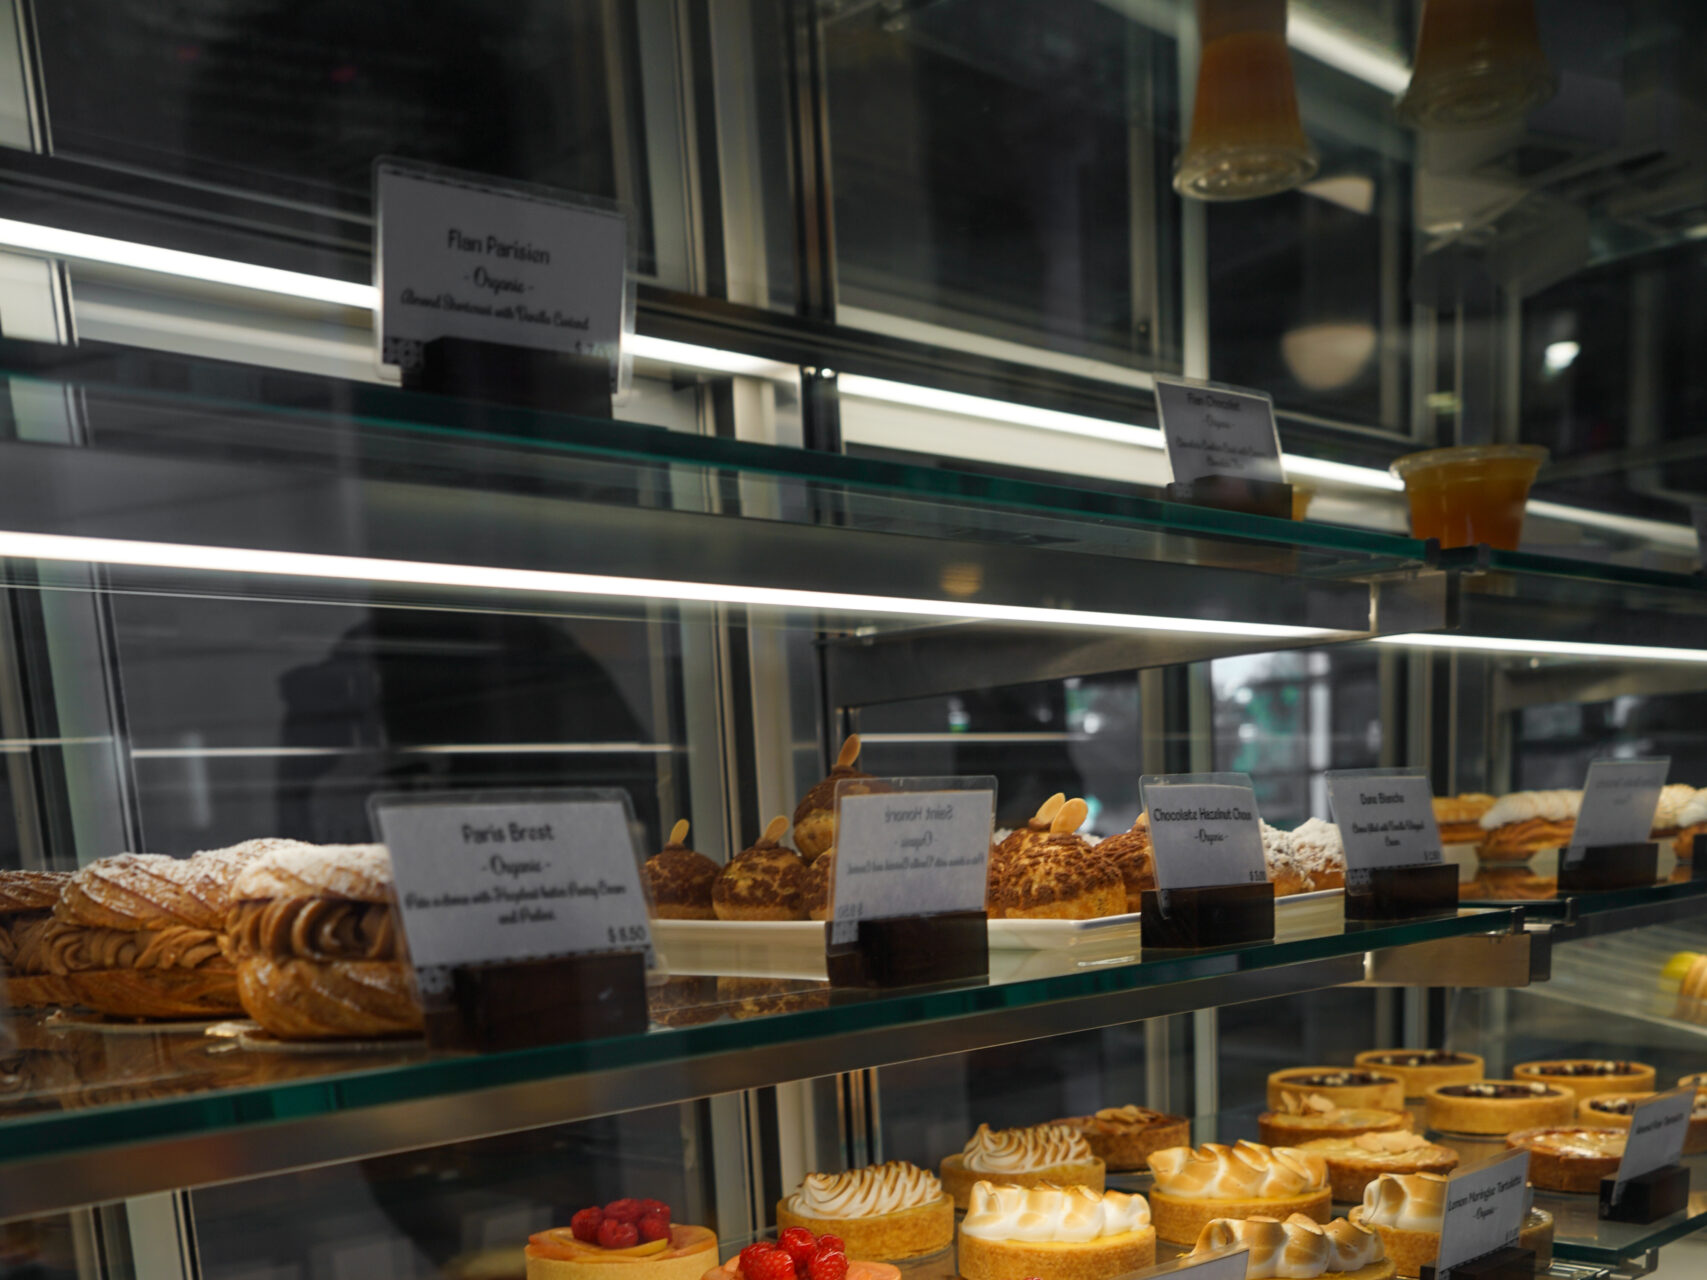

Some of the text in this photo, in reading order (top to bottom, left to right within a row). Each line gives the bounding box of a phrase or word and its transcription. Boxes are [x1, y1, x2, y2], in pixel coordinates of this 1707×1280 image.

[447, 228, 550, 265] Flan Parisien
[473, 265, 525, 296] Organic
[1153, 807, 1197, 822] Chocolate
[1199, 807, 1232, 820] Hazelnut
[461, 822, 555, 844] Paris Brest
[489, 856, 541, 879] Organic
